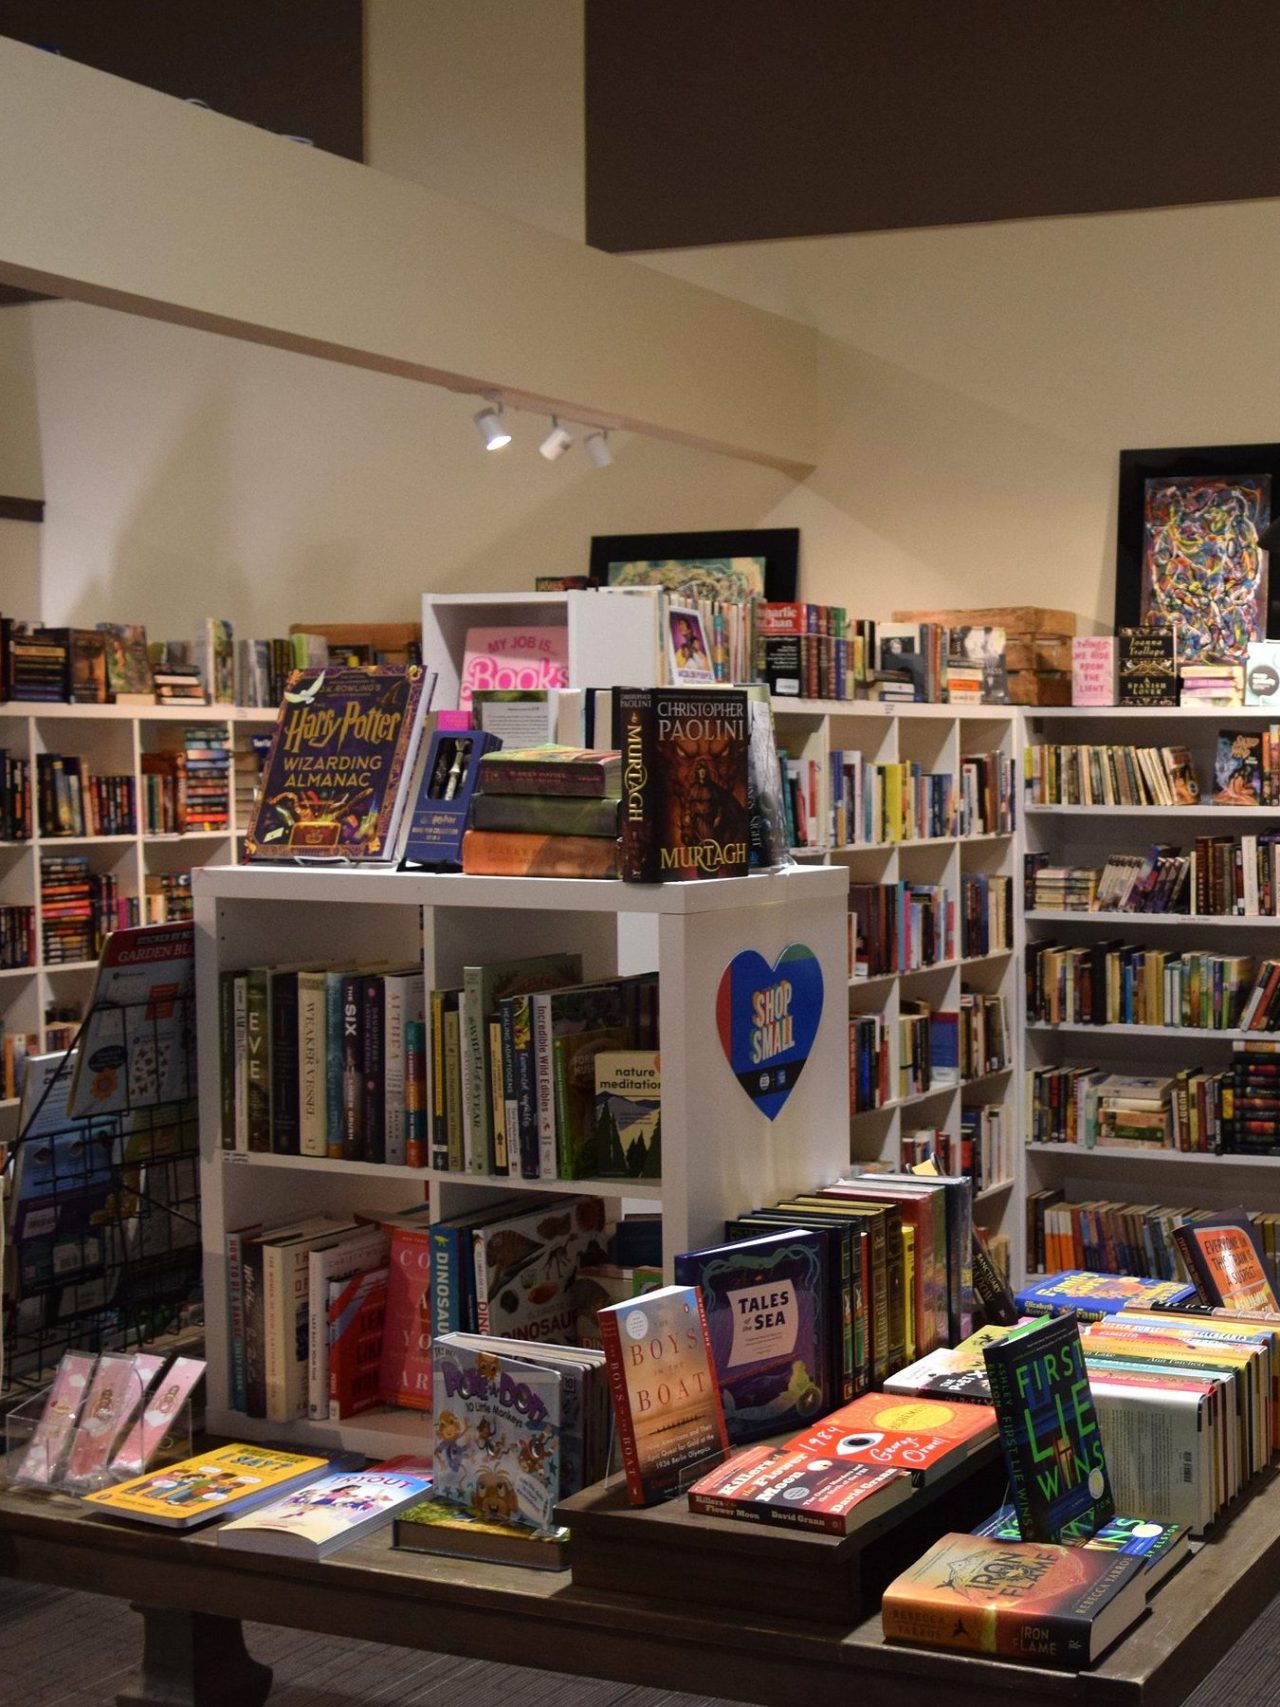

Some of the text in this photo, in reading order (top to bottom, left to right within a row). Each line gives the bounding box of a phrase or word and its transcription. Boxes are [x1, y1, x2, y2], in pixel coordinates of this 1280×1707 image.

[487, 635, 536, 654] MY JOB
[656, 701, 745, 718] CHRISTOPHER
[283, 701, 401, 755] Harry Potter
[657, 719, 745, 742] PAOLINI
[282, 755, 383, 772] WIZARDING
[284, 773, 371, 788] ALMANAC
[624, 724, 648, 823] MURTAGH
[660, 838, 747, 873] MURTAGH
[118, 944, 171, 963] GARDEN
[344, 1003, 358, 1037] SIX
[752, 980, 793, 1028] SHOP
[248, 1011, 262, 1080] EVE
[304, 1001, 316, 1066] WEAKER
[502, 1007, 514, 1094] HEALING ADAPTOGENS
[752, 1014, 796, 1065] SMALL
[537, 1005, 551, 1113] Incredible Wild Edibles
[614, 1066, 656, 1078] nature
[976, 1253, 1000, 1292] SANCTUARY
[738, 1290, 789, 1314] TALES
[753, 1311, 786, 1330] SEA
[630, 1327, 698, 1367] BOYS
[1166, 1358, 1206, 1367] Patchett
[1015, 1339, 1084, 1399] FIRST
[636, 1373, 705, 1413] BOAT
[475, 1404, 493, 1414] Little
[494, 1407, 524, 1429] Monkeys
[1023, 1378, 1097, 1463] LIE
[798, 1426, 846, 1453] 1984
[869, 1436, 921, 1461] George
[902, 1436, 952, 1463] Orwell
[330, 1475, 416, 1490] TRYOUT
[717, 1457, 776, 1497] Killers
[752, 1452, 809, 1488] Flower
[755, 1470, 807, 1503] Moon
[1002, 1416, 1033, 1528] FIRST LIE WINS
[1036, 1439, 1105, 1502] WINS
[695, 1495, 725, 1506] Killers
[829, 1467, 898, 1514] David Grann
[705, 1504, 761, 1520] Flower Moon
[771, 1509, 826, 1527] David Grann
[964, 1551, 1028, 1591] IRON
[998, 1552, 1060, 1599] FLAME
[1075, 1555, 1134, 1615] REBECCA YARROS
[1012, 1636, 1057, 1656] FLAME
[1019, 1624, 1049, 1641] IRON
